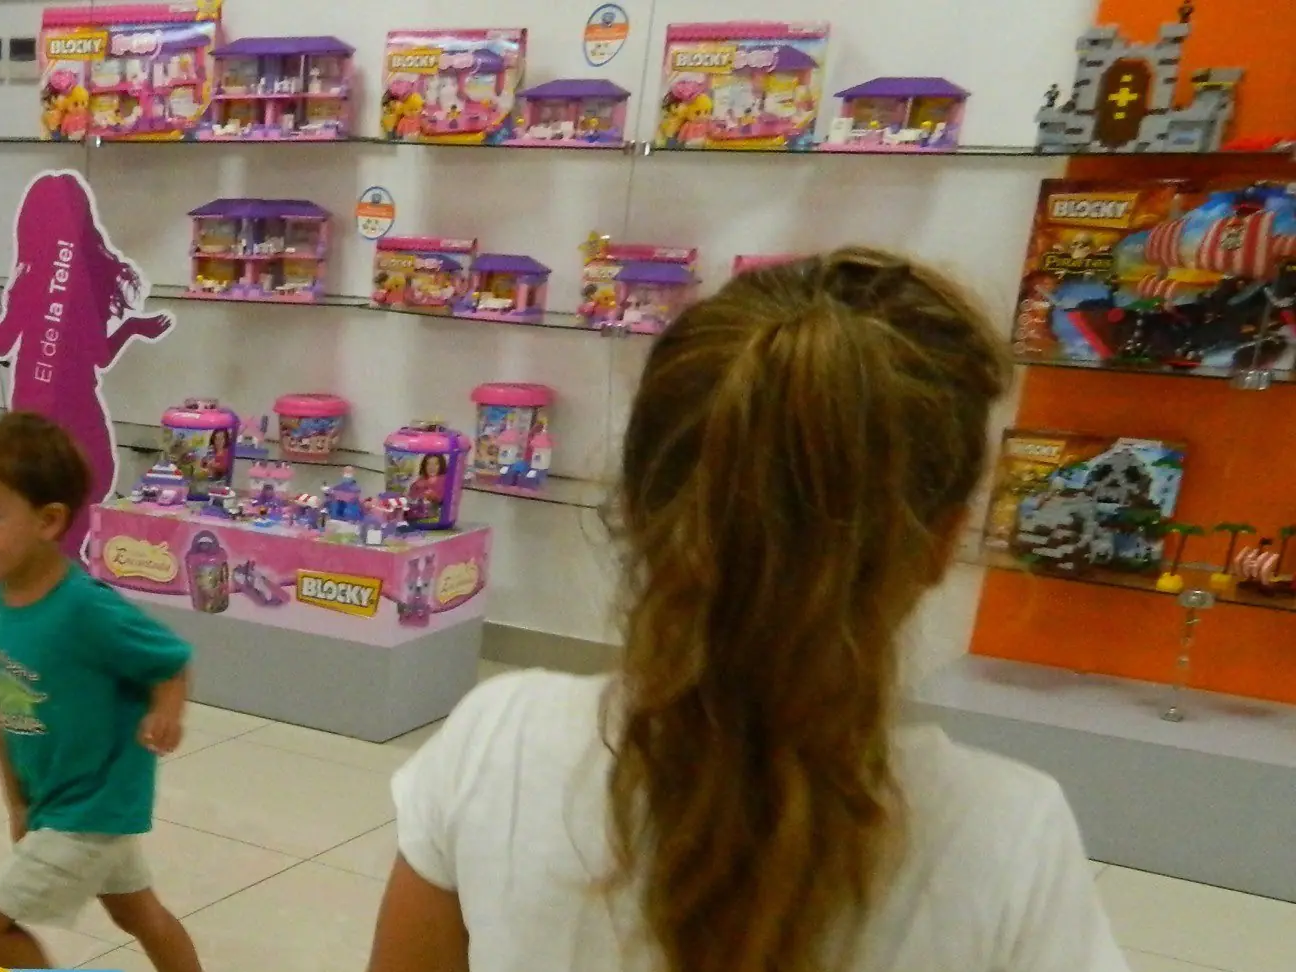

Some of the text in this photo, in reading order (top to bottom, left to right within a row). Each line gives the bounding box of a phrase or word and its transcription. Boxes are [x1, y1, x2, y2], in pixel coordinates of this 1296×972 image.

[35, 239, 74, 383] El de la Tele!
[302, 576, 374, 607] BLOCKY
